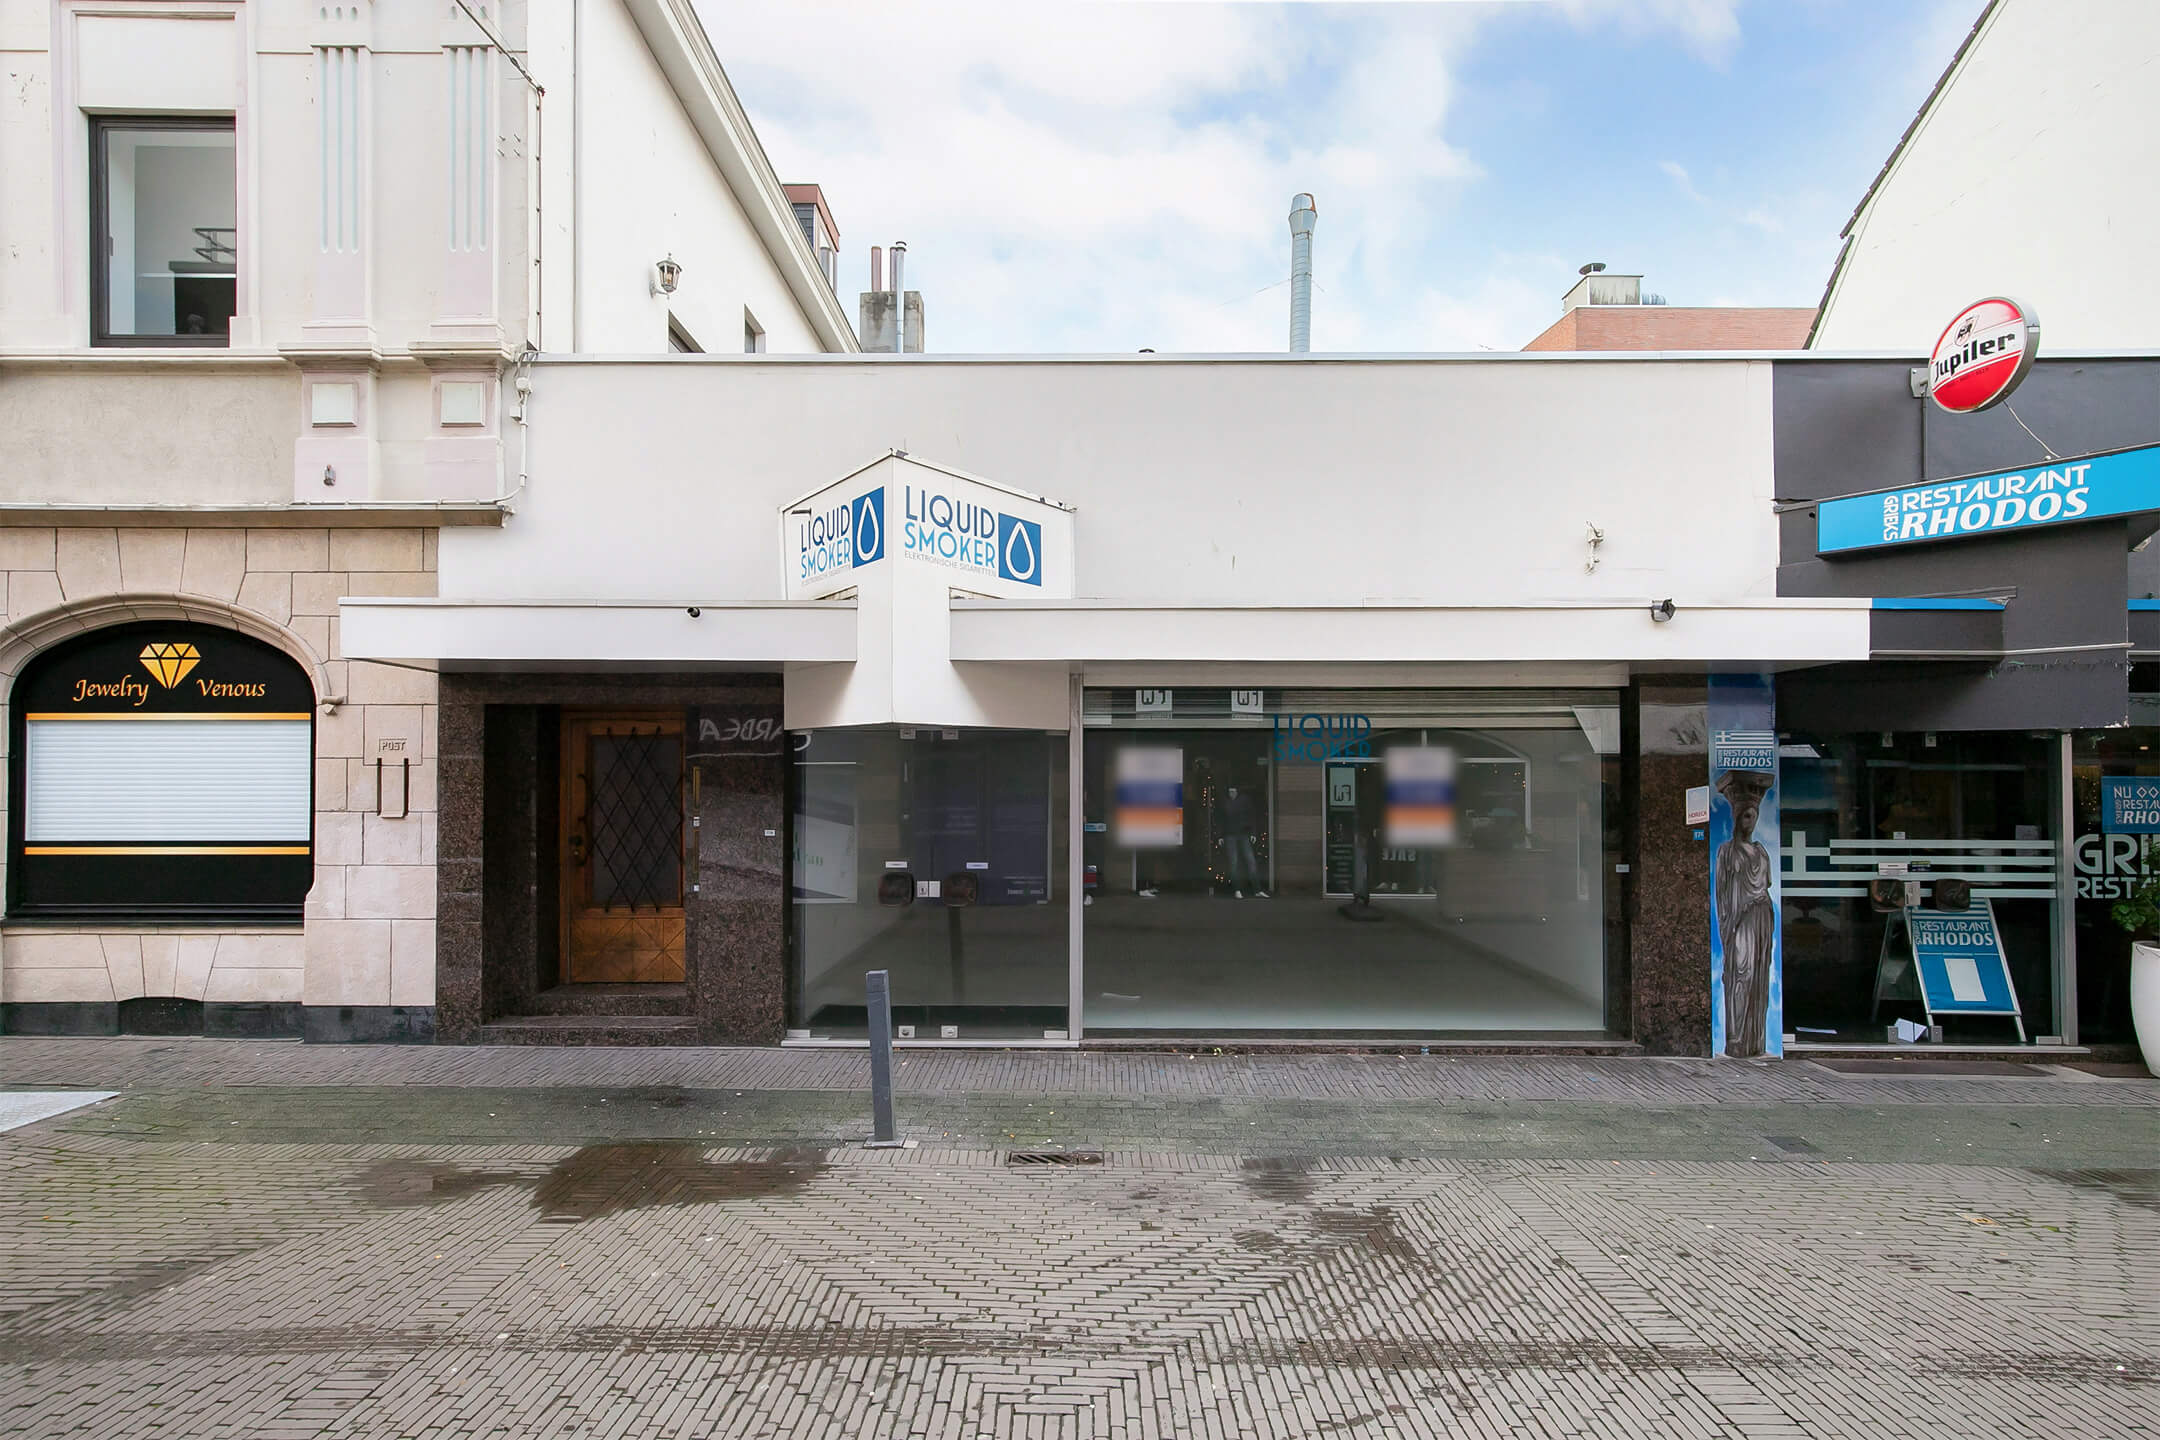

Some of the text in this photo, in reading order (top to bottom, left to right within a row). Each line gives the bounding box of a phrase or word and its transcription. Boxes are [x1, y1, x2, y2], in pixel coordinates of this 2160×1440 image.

[1934, 331, 2016, 383] Jupiler
[1902, 464, 2091, 512] RESTAURANT
[800, 505, 850, 552] LIQUID
[905, 485, 995, 538] LIQUID
[1883, 495, 1899, 541] GRIEKS
[1900, 487, 2090, 539] RHODOS
[800, 537, 850, 578] SMOKER
[904, 522, 995, 568] SMOKER
[73, 674, 266, 706] Jewelry Venous
[1273, 713, 1371, 739] LIQUID
[382, 741, 406, 751] POST
[1723, 749, 1771, 757] RESTAURANT
[1723, 757, 1772, 767] RHODOS
[2113, 786, 2132, 799] NU
[1919, 921, 1990, 931] RESTAURANT
[1922, 932, 1994, 946] RHODOS
